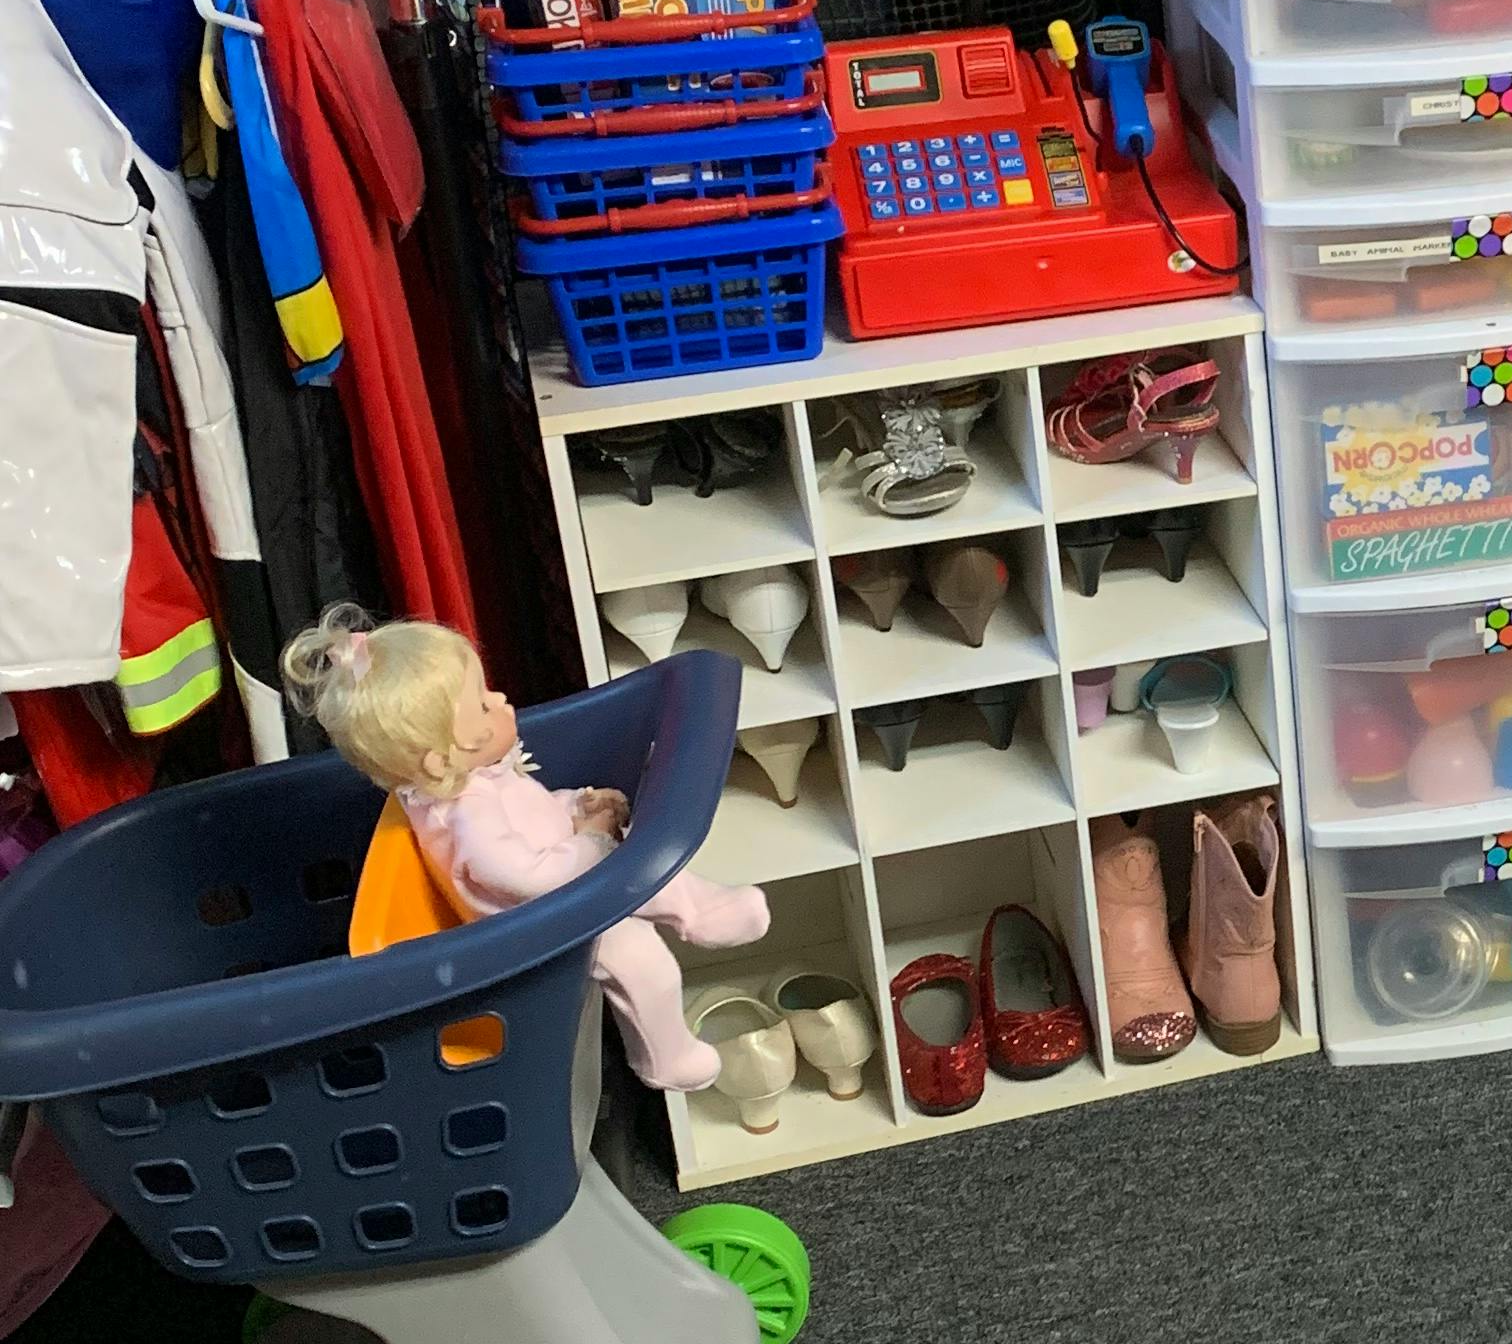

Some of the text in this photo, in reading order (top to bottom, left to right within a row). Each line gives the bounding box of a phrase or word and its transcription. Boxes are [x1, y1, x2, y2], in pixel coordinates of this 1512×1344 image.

[852, 61, 866, 107] TOTAL
[865, 144, 876, 156] 1
[897, 141, 913, 153] 2
[930, 137, 945, 149] 3
[868, 161, 885, 174] 4
[902, 158, 917, 171] 5
[934, 154, 951, 167] 6
[1000, 157, 1022, 169] MIC
[872, 180, 887, 193] 7
[905, 176, 922, 189] 8
[1332, 433, 1473, 473] POPCORN
[1336, 516, 1404, 538] ORGANIC
[1407, 510, 1462, 528] WHOLE
